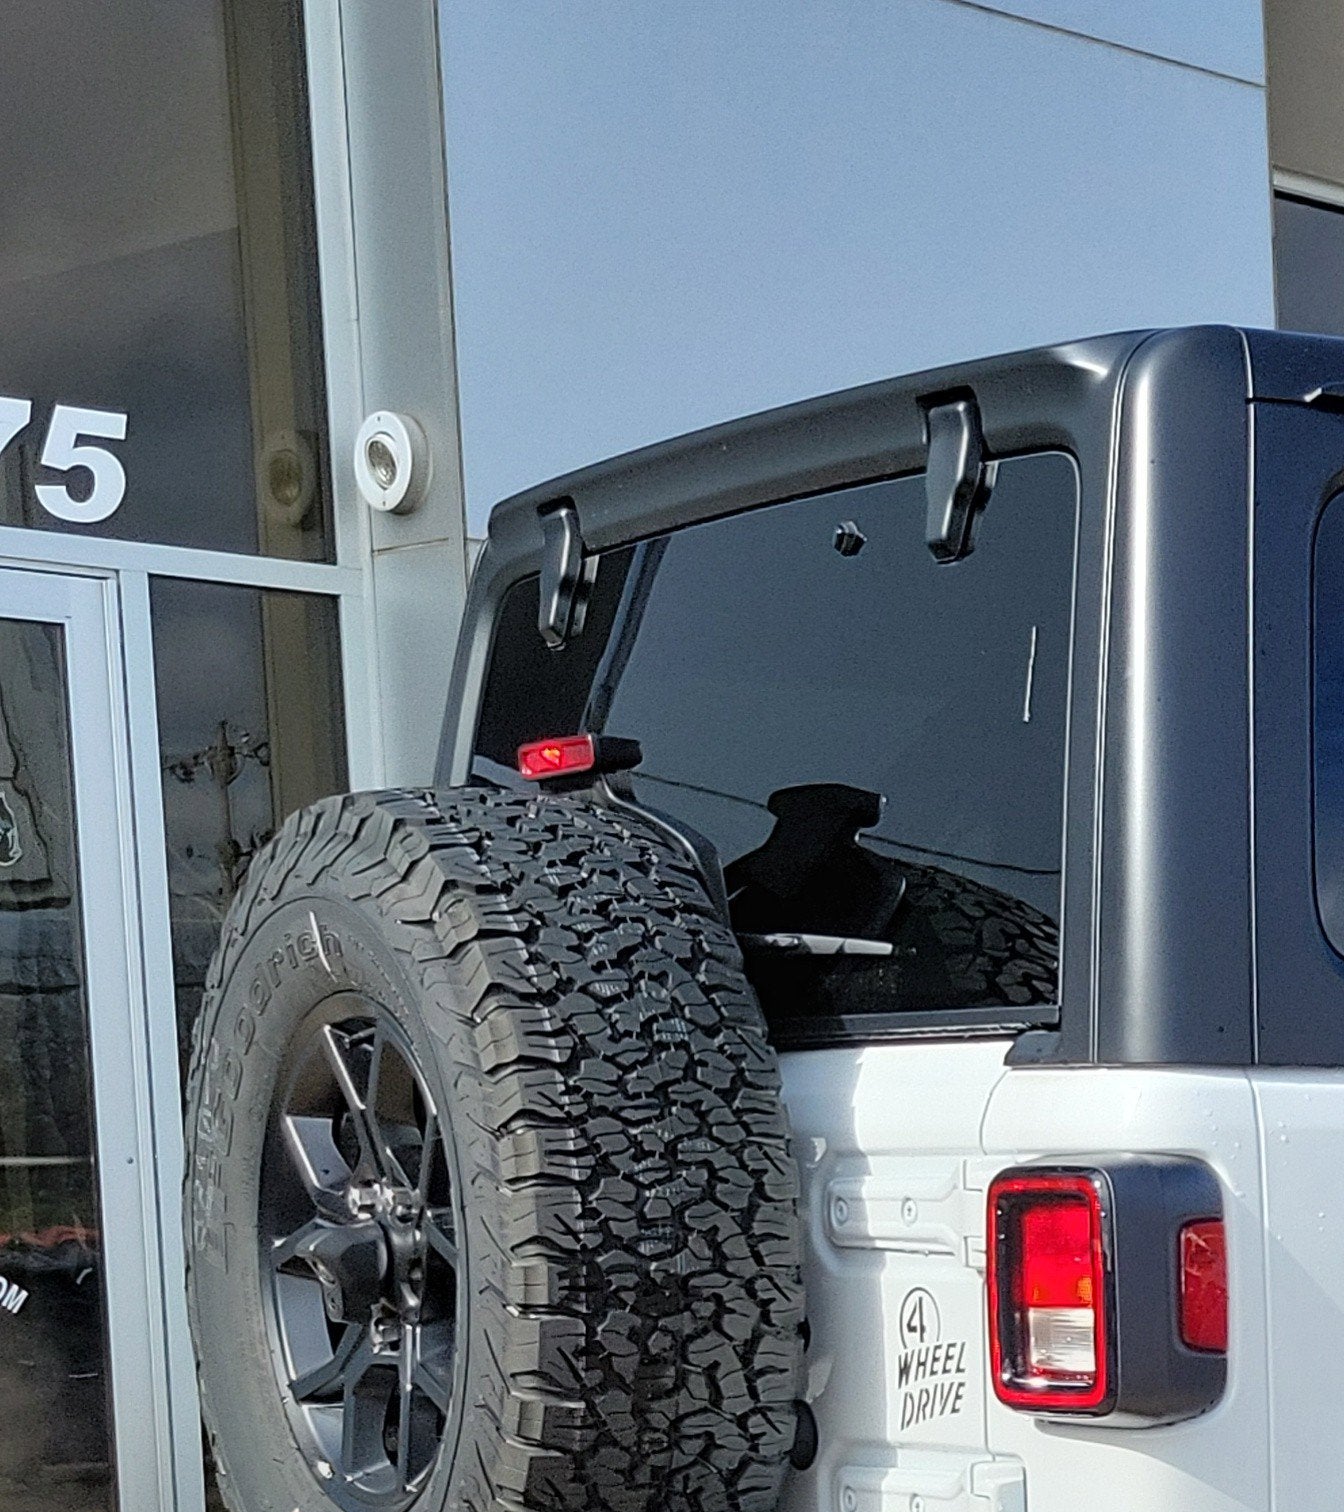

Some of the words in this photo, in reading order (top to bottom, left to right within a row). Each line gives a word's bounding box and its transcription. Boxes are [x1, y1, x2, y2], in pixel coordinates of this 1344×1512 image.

[906, 1296, 926, 1343] 4
[899, 1342, 965, 1389] WHEEL
[901, 1382, 965, 1431] DRIVE
